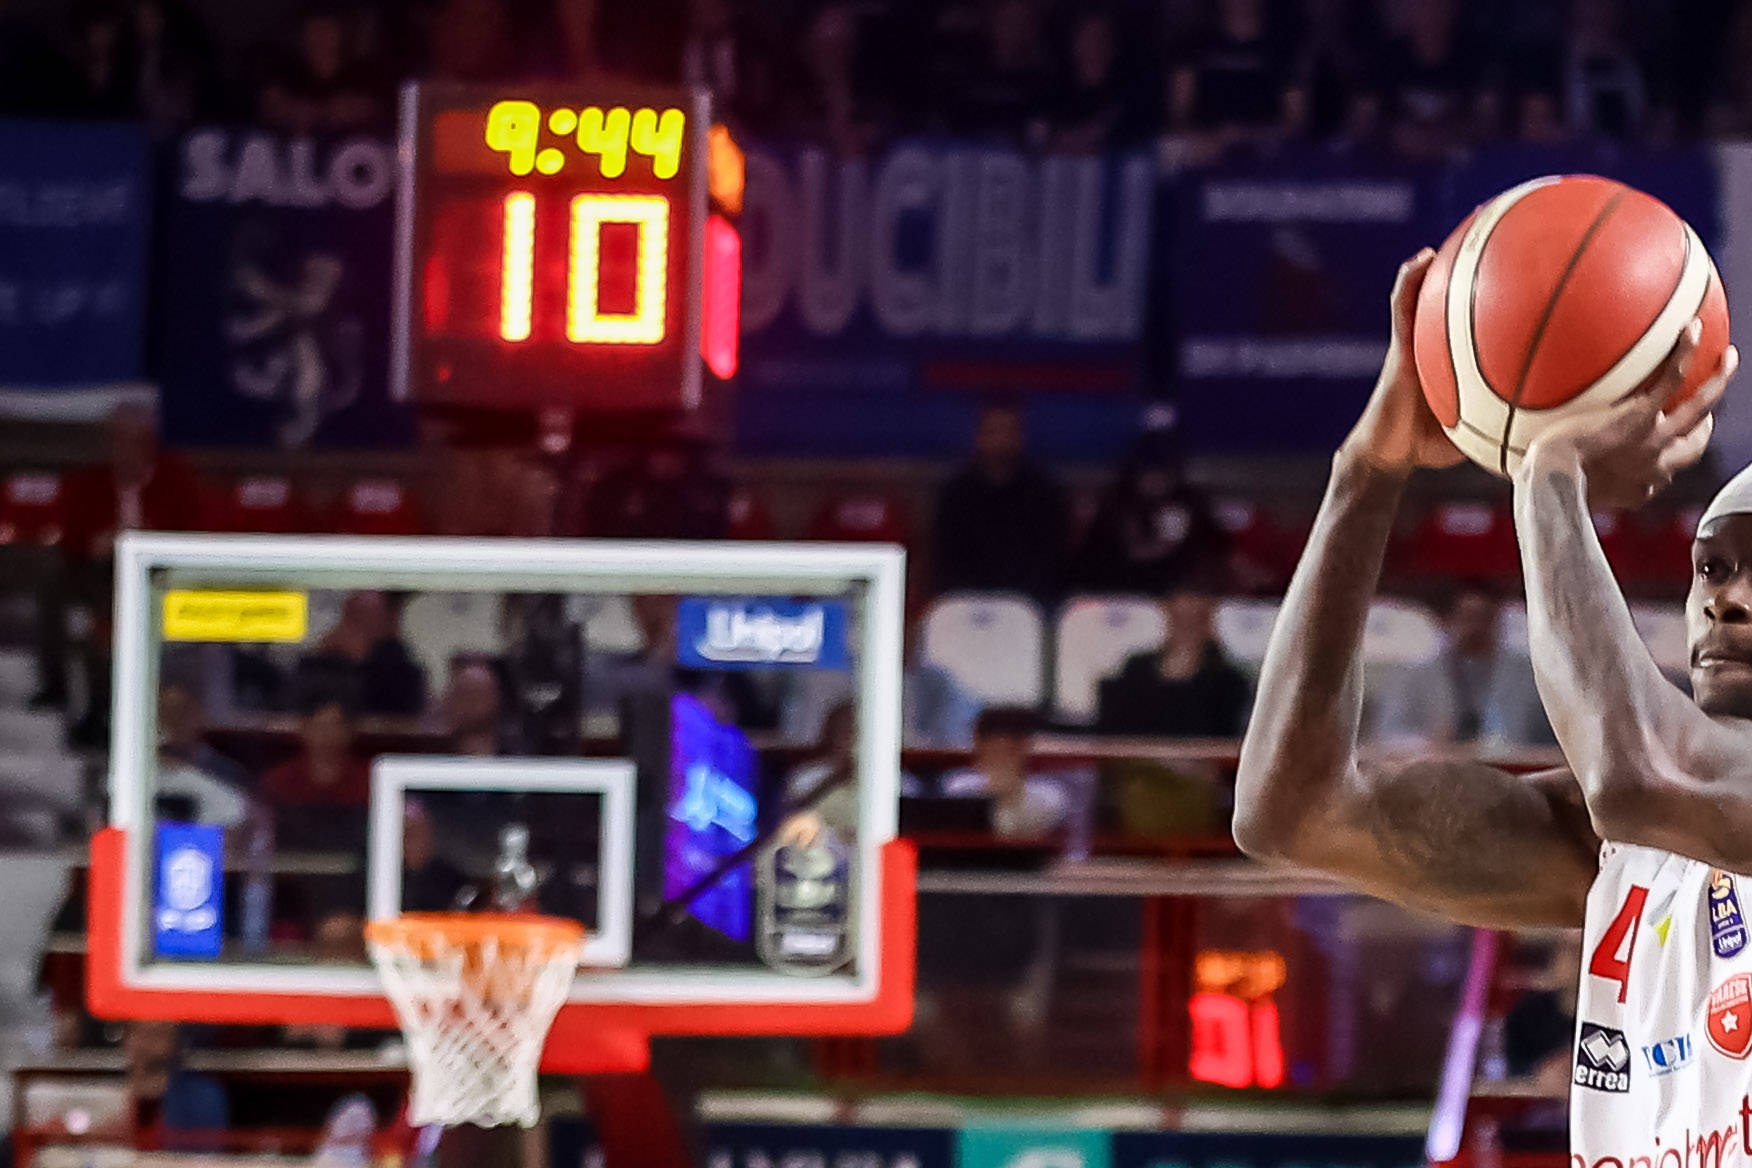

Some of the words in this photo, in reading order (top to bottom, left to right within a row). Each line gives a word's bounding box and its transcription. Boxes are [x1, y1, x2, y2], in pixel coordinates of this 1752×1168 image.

[486, 100, 685, 179] 9:44
[500, 192, 670, 345] 10
[1589, 885, 1649, 1003] 4
